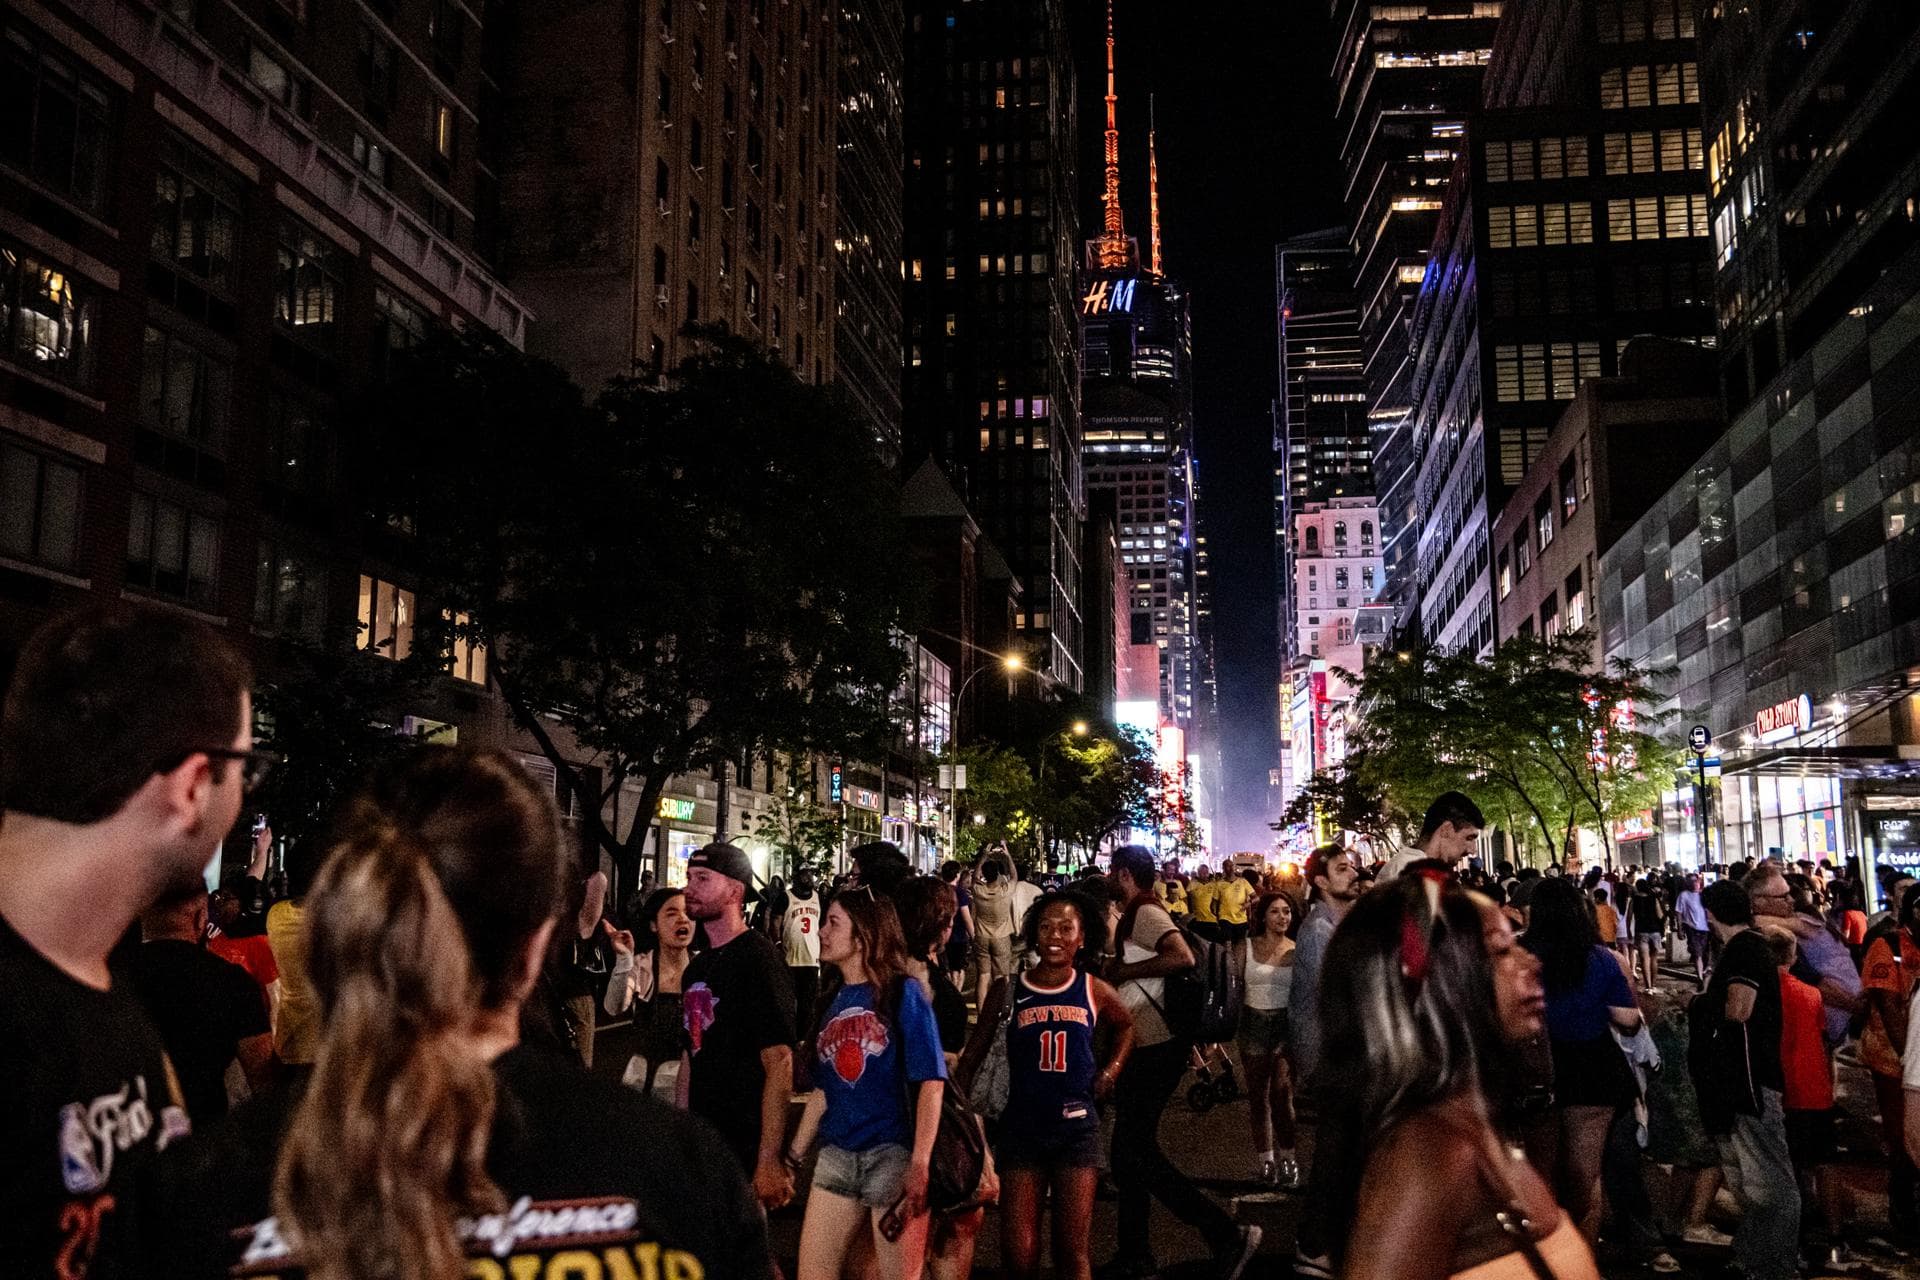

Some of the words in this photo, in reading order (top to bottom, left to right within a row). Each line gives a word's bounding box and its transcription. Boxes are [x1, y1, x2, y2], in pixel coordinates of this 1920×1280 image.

[1082, 279, 1136, 315] H&M
[1092, 416, 1129, 424] THOMSON
[1130, 416, 1164, 424] REUTERS
[1756, 707, 1774, 739] COLD
[1775, 697, 1799, 728] STONE
[832, 773, 841, 798] GYM
[659, 797, 695, 820] SUBWAY
[1877, 852, 1888, 865] 4
[1889, 851, 1920, 865] telé
[800, 917, 811, 934] 3
[1018, 1005, 1049, 1029] NEW
[1050, 1004, 1089, 1028] YORK
[1039, 1030, 1067, 1073] 11
